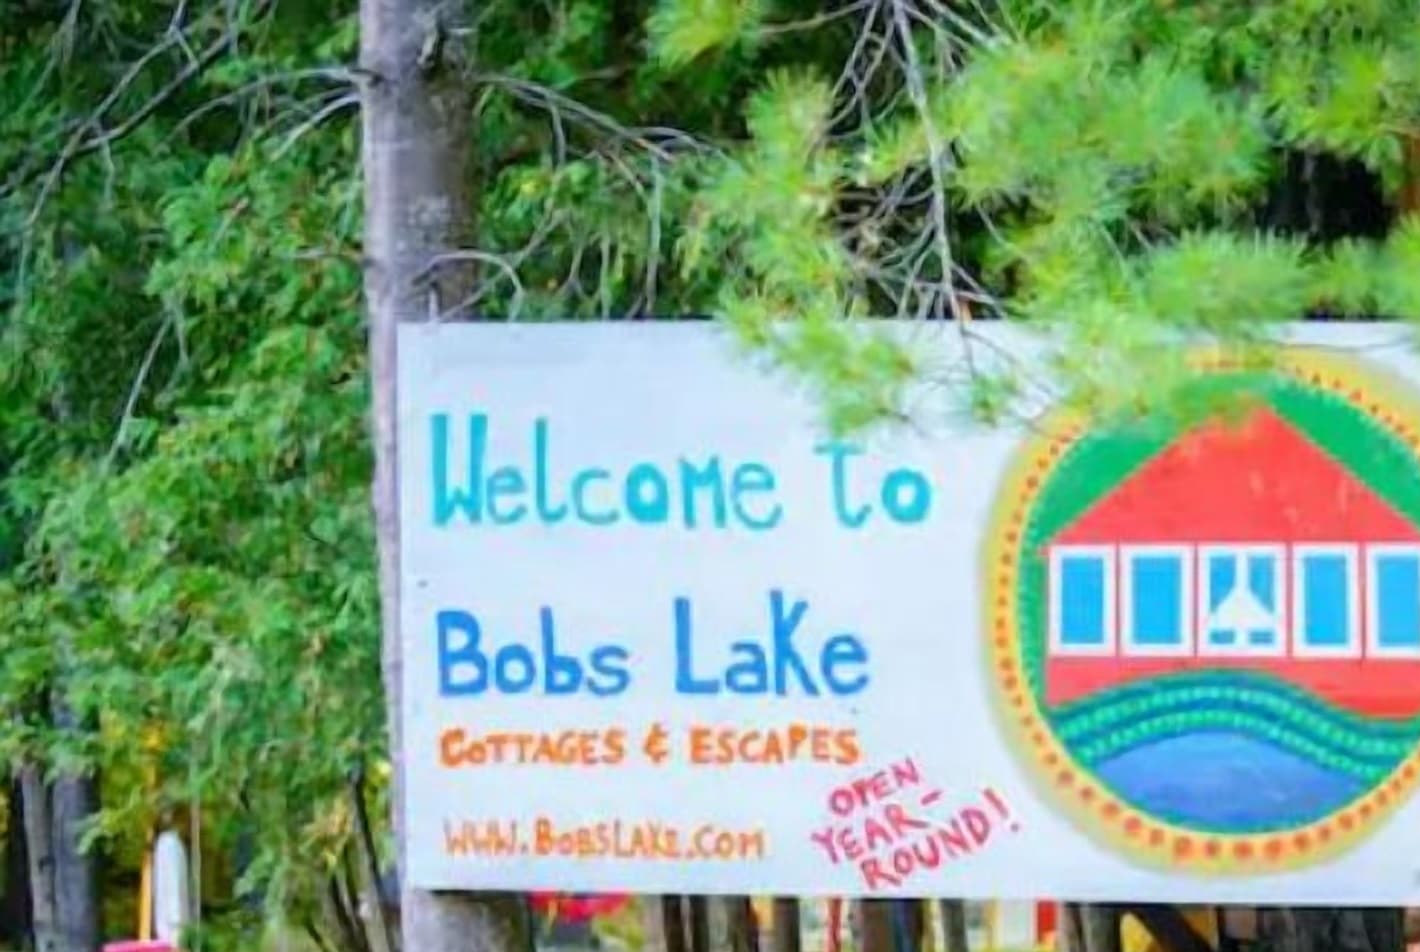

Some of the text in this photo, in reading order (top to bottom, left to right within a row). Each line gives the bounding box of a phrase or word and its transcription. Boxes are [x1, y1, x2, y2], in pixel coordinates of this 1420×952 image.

[436, 605, 630, 698] Bobs
[642, 725, 668, 763] &
[689, 727, 860, 764] ESCAPES
[826, 755, 923, 819] OPEN
[859, 788, 1021, 891] ROUND!
